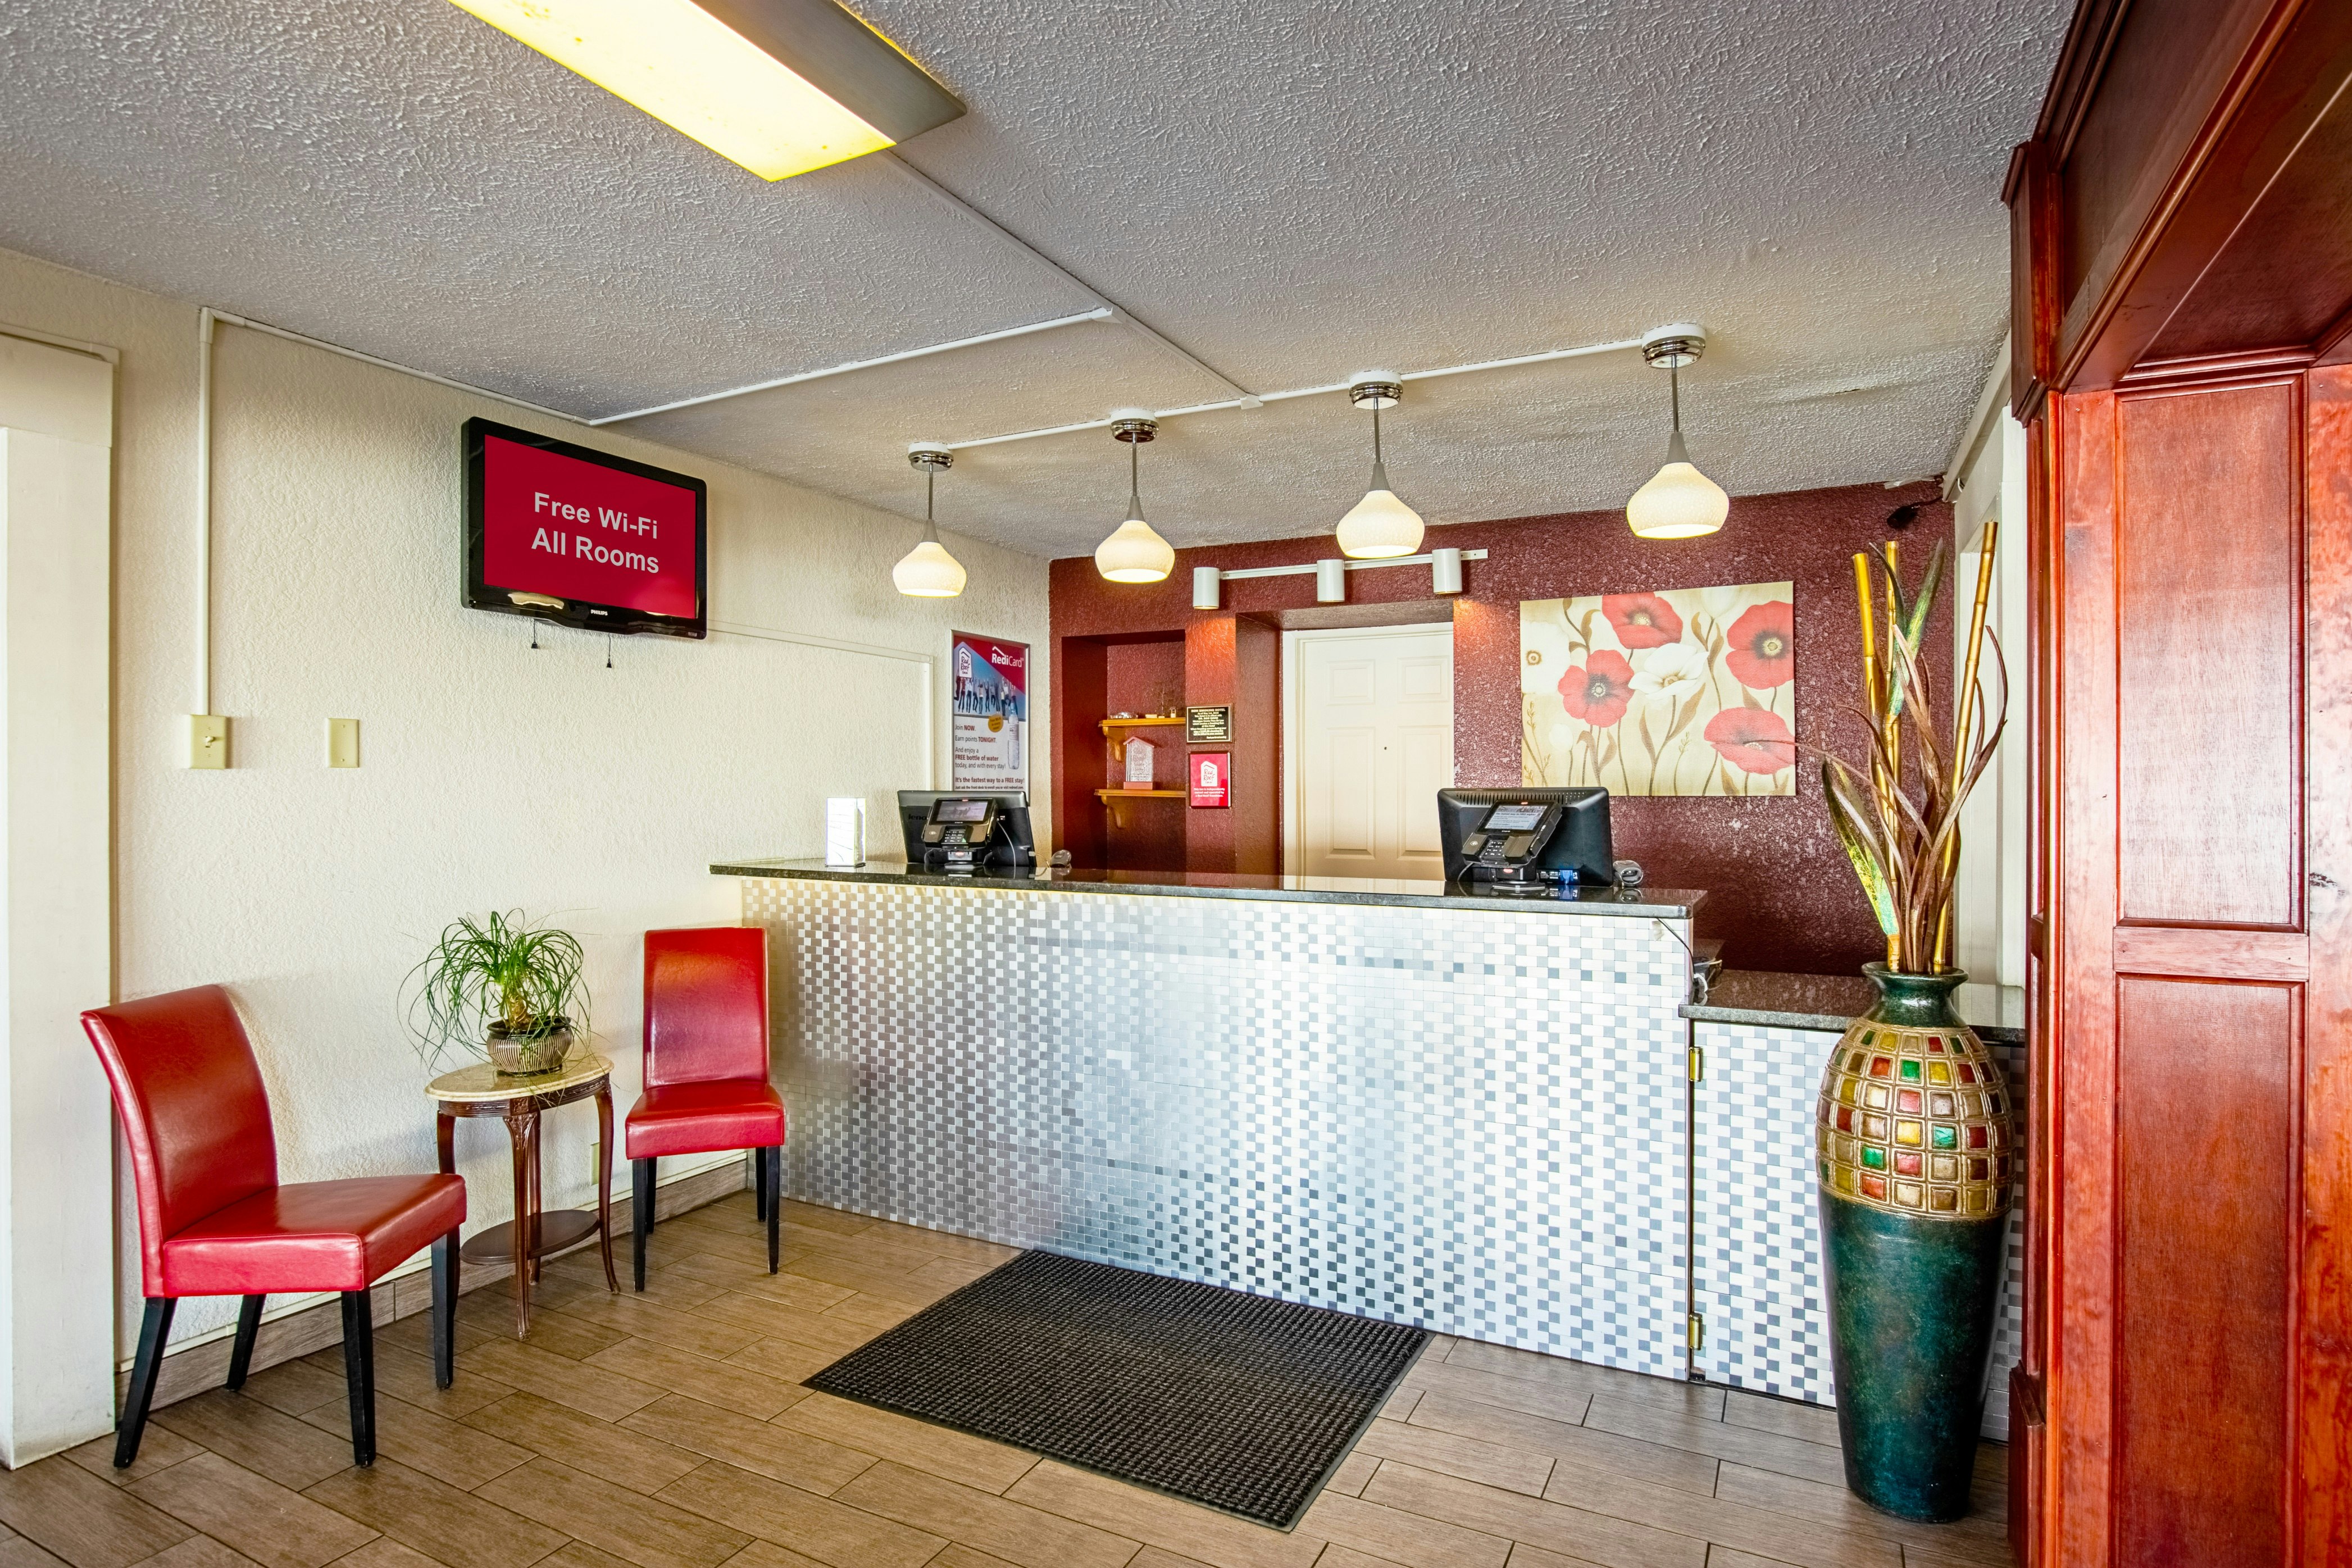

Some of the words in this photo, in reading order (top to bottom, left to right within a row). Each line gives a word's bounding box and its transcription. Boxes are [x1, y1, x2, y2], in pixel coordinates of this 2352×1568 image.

[535, 492, 590, 523] Free
[598, 507, 657, 539] Wi-Fi
[531, 527, 566, 555] All
[576, 536, 659, 573] Rooms
[992, 653, 1022, 667] RediCard
